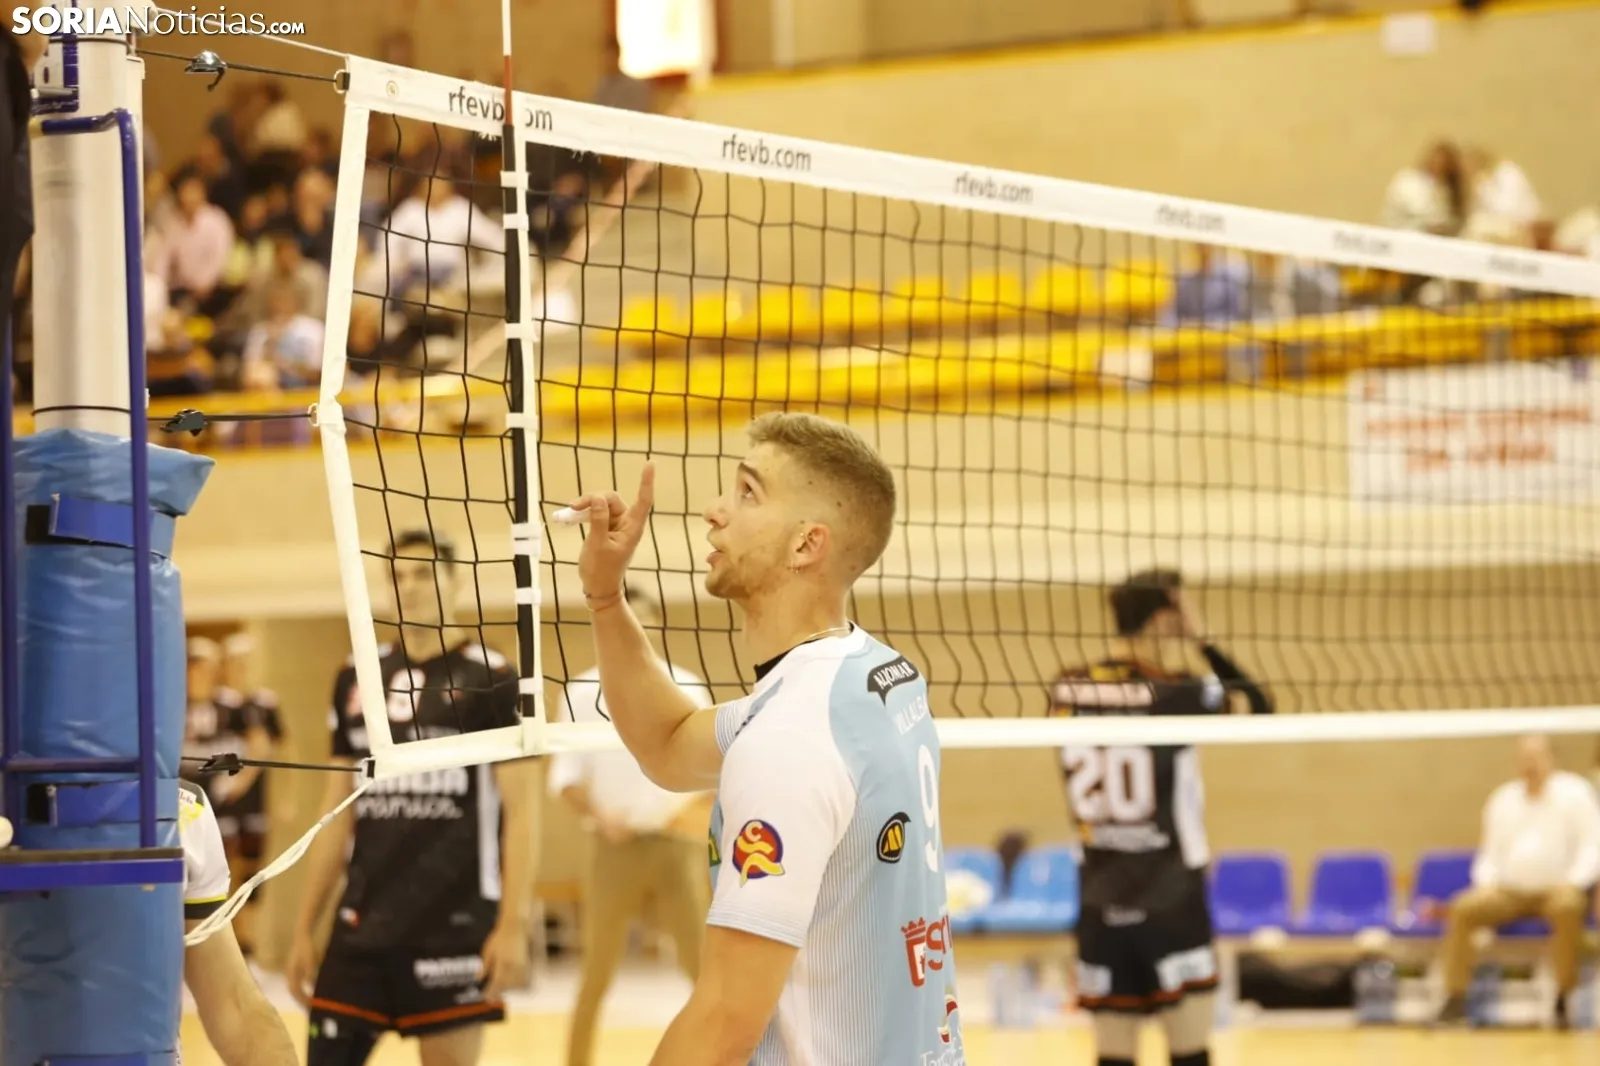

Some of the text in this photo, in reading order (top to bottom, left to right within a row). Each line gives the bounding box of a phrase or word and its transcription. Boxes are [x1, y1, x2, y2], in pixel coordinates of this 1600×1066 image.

[722, 134, 812, 172] rfevb.com
[954, 172, 1034, 205] rfevb.com
[918, 744, 939, 873] 9
[1061, 745, 1153, 823] 20
